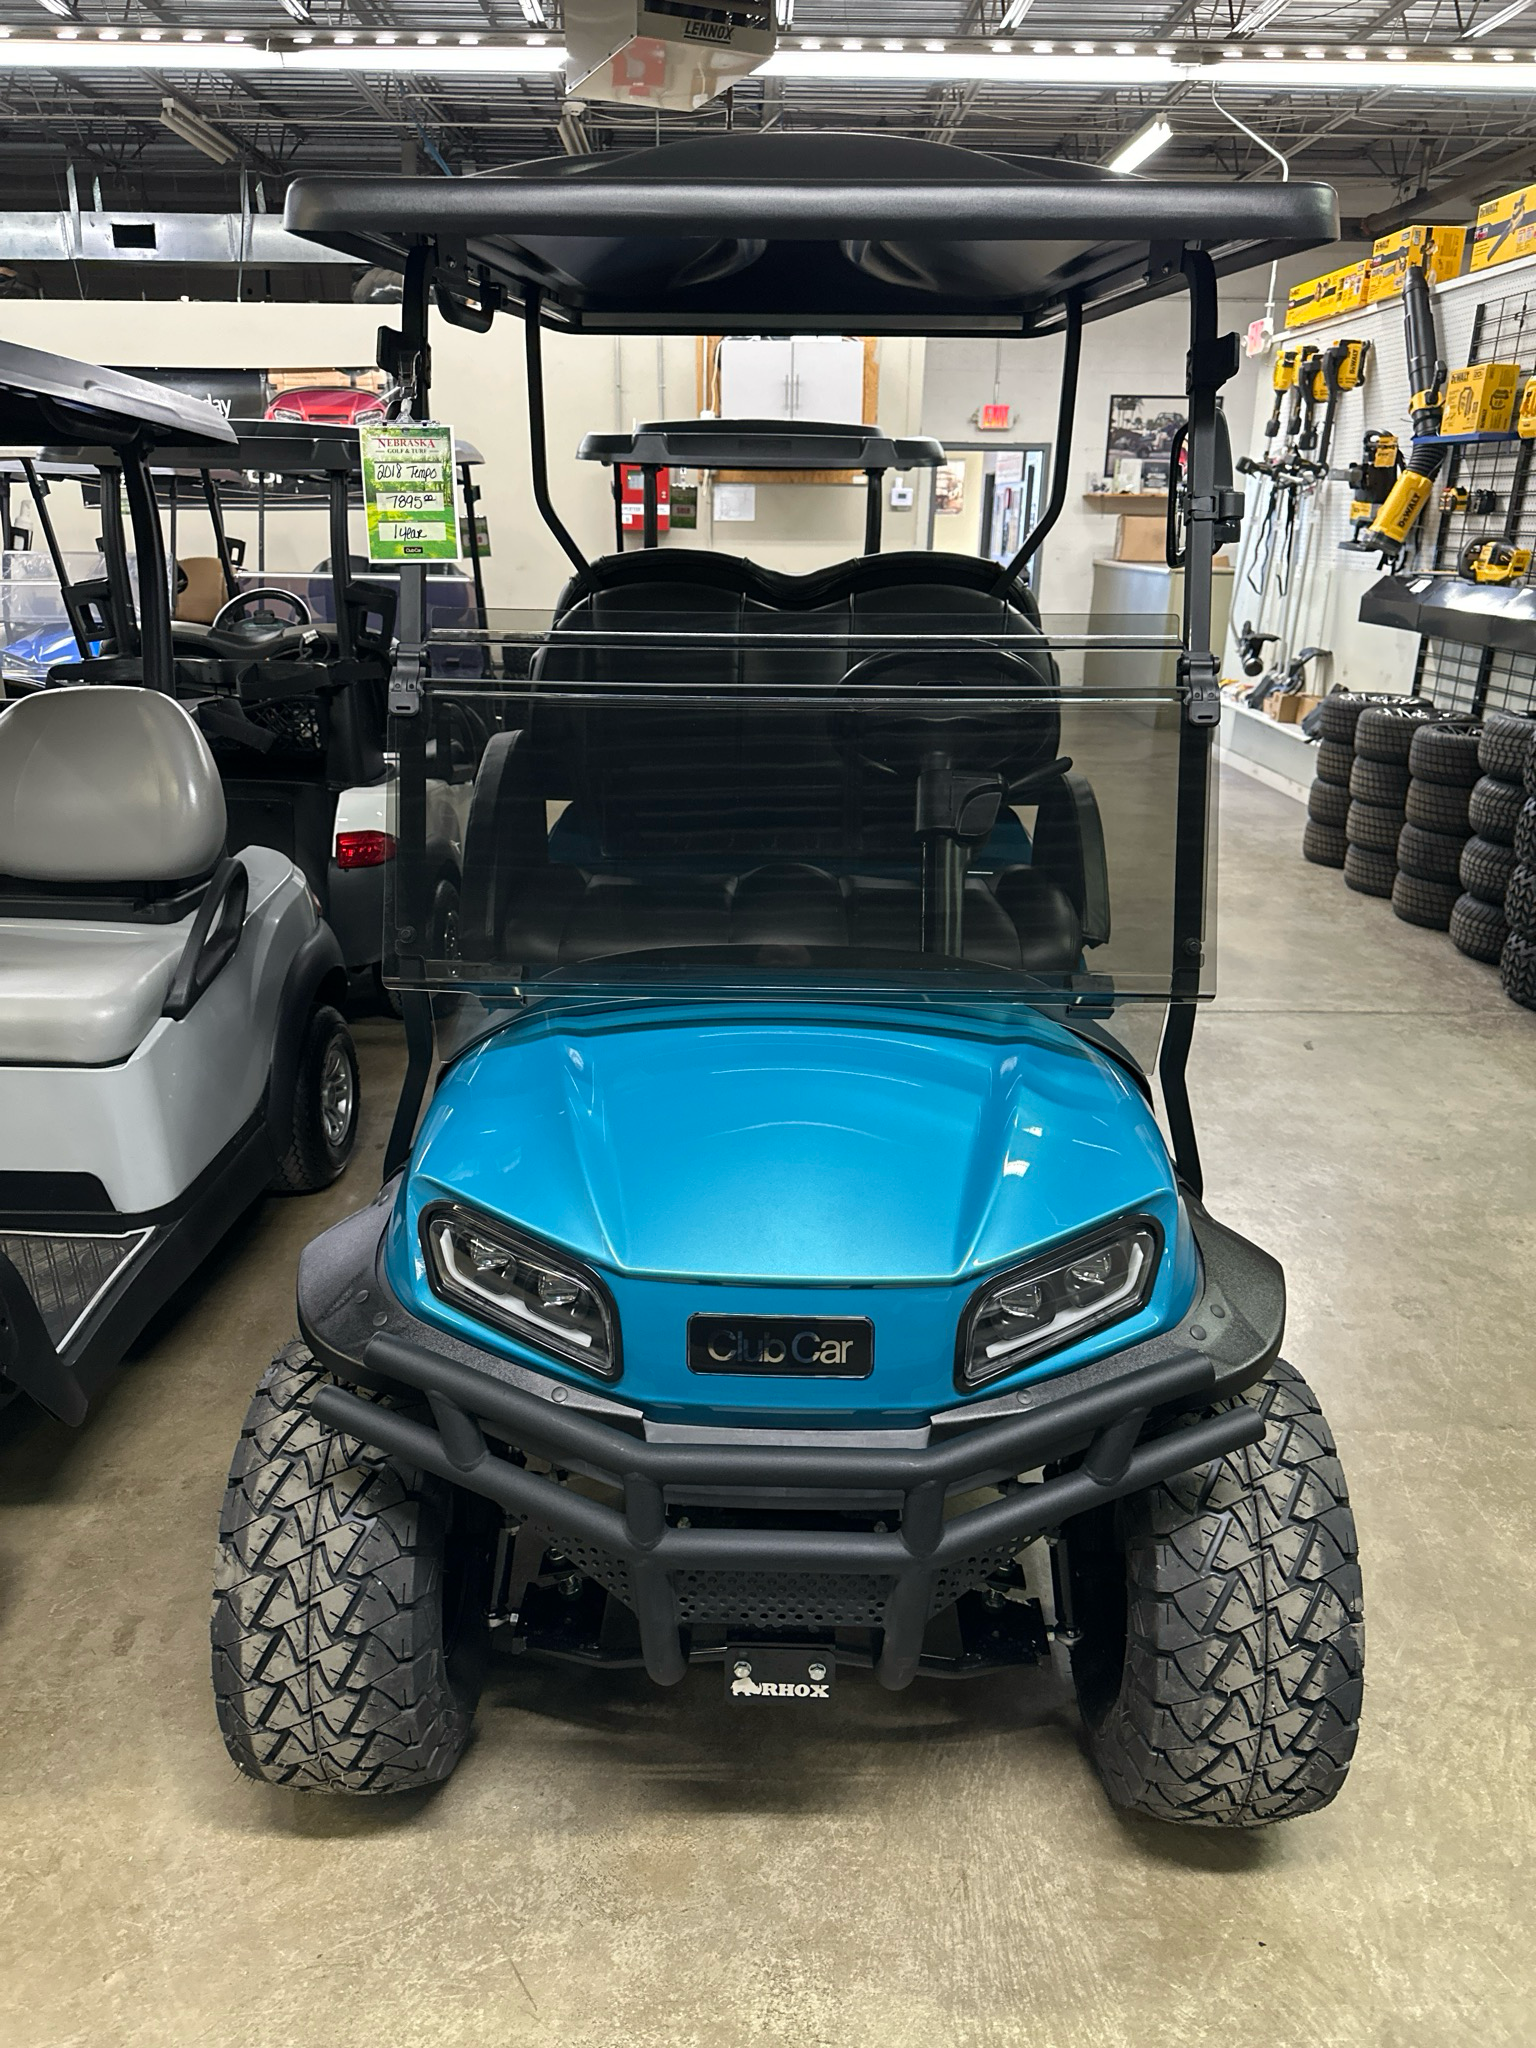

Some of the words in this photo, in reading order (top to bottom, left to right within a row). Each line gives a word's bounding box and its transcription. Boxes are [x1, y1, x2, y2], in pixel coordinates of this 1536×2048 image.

[685, 20, 735, 40] LENNOX
[377, 438, 436, 449] NEBRASKA
[377, 463, 402, 480] 2018
[406, 465, 437, 482] Tempo
[1397, 493, 1420, 528] DEWALT
[707, 1329, 787, 1363] Club
[791, 1331, 854, 1364] Car
[761, 1682, 829, 1698] RHOX
